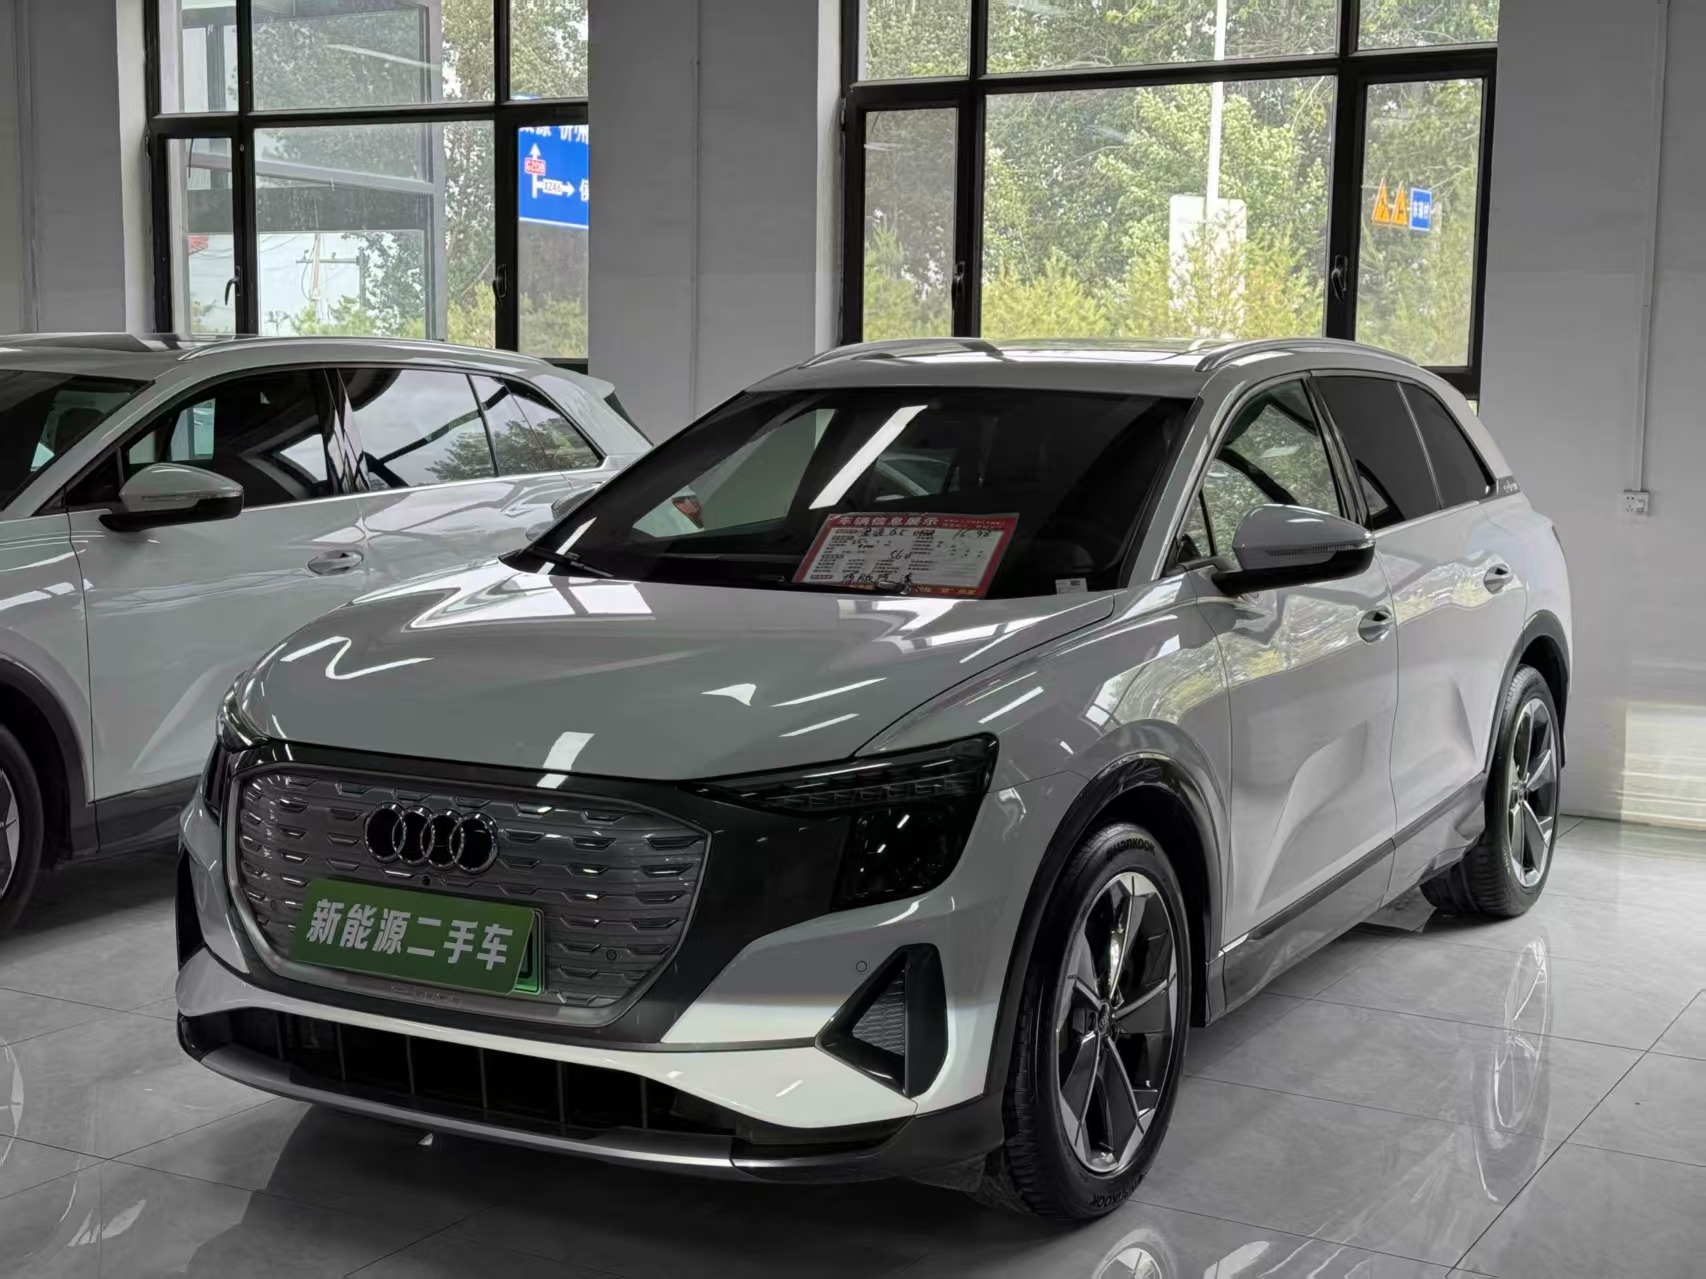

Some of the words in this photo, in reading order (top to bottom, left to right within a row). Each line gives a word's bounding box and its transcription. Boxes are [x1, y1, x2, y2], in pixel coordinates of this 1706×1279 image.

[306, 899, 513, 971] 新能源二手车
